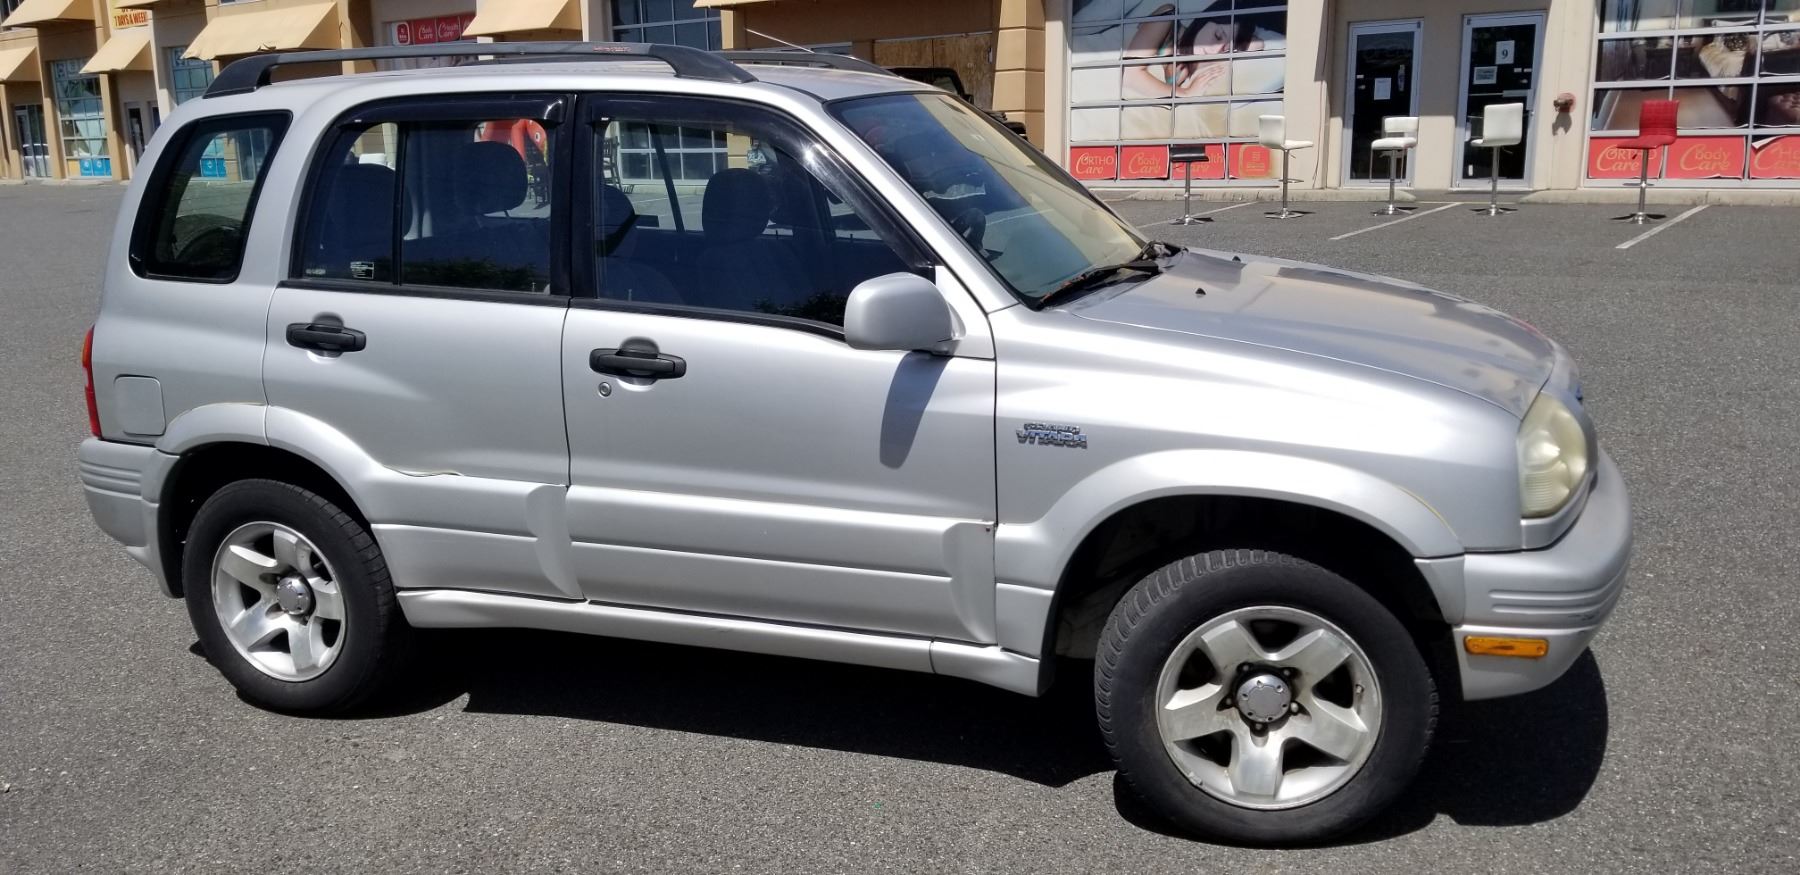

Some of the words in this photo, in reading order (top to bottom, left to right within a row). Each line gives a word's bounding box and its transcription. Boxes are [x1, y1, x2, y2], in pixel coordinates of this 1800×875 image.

[1502, 49, 1509, 59] 9
[1075, 152, 1104, 175] Care
[1080, 155, 1115, 166] ORTHO
[1128, 151, 1160, 174] Care
[1597, 144, 1640, 171] Care
[1680, 143, 1730, 171] Care
[1016, 429, 1088, 447] VITARA
